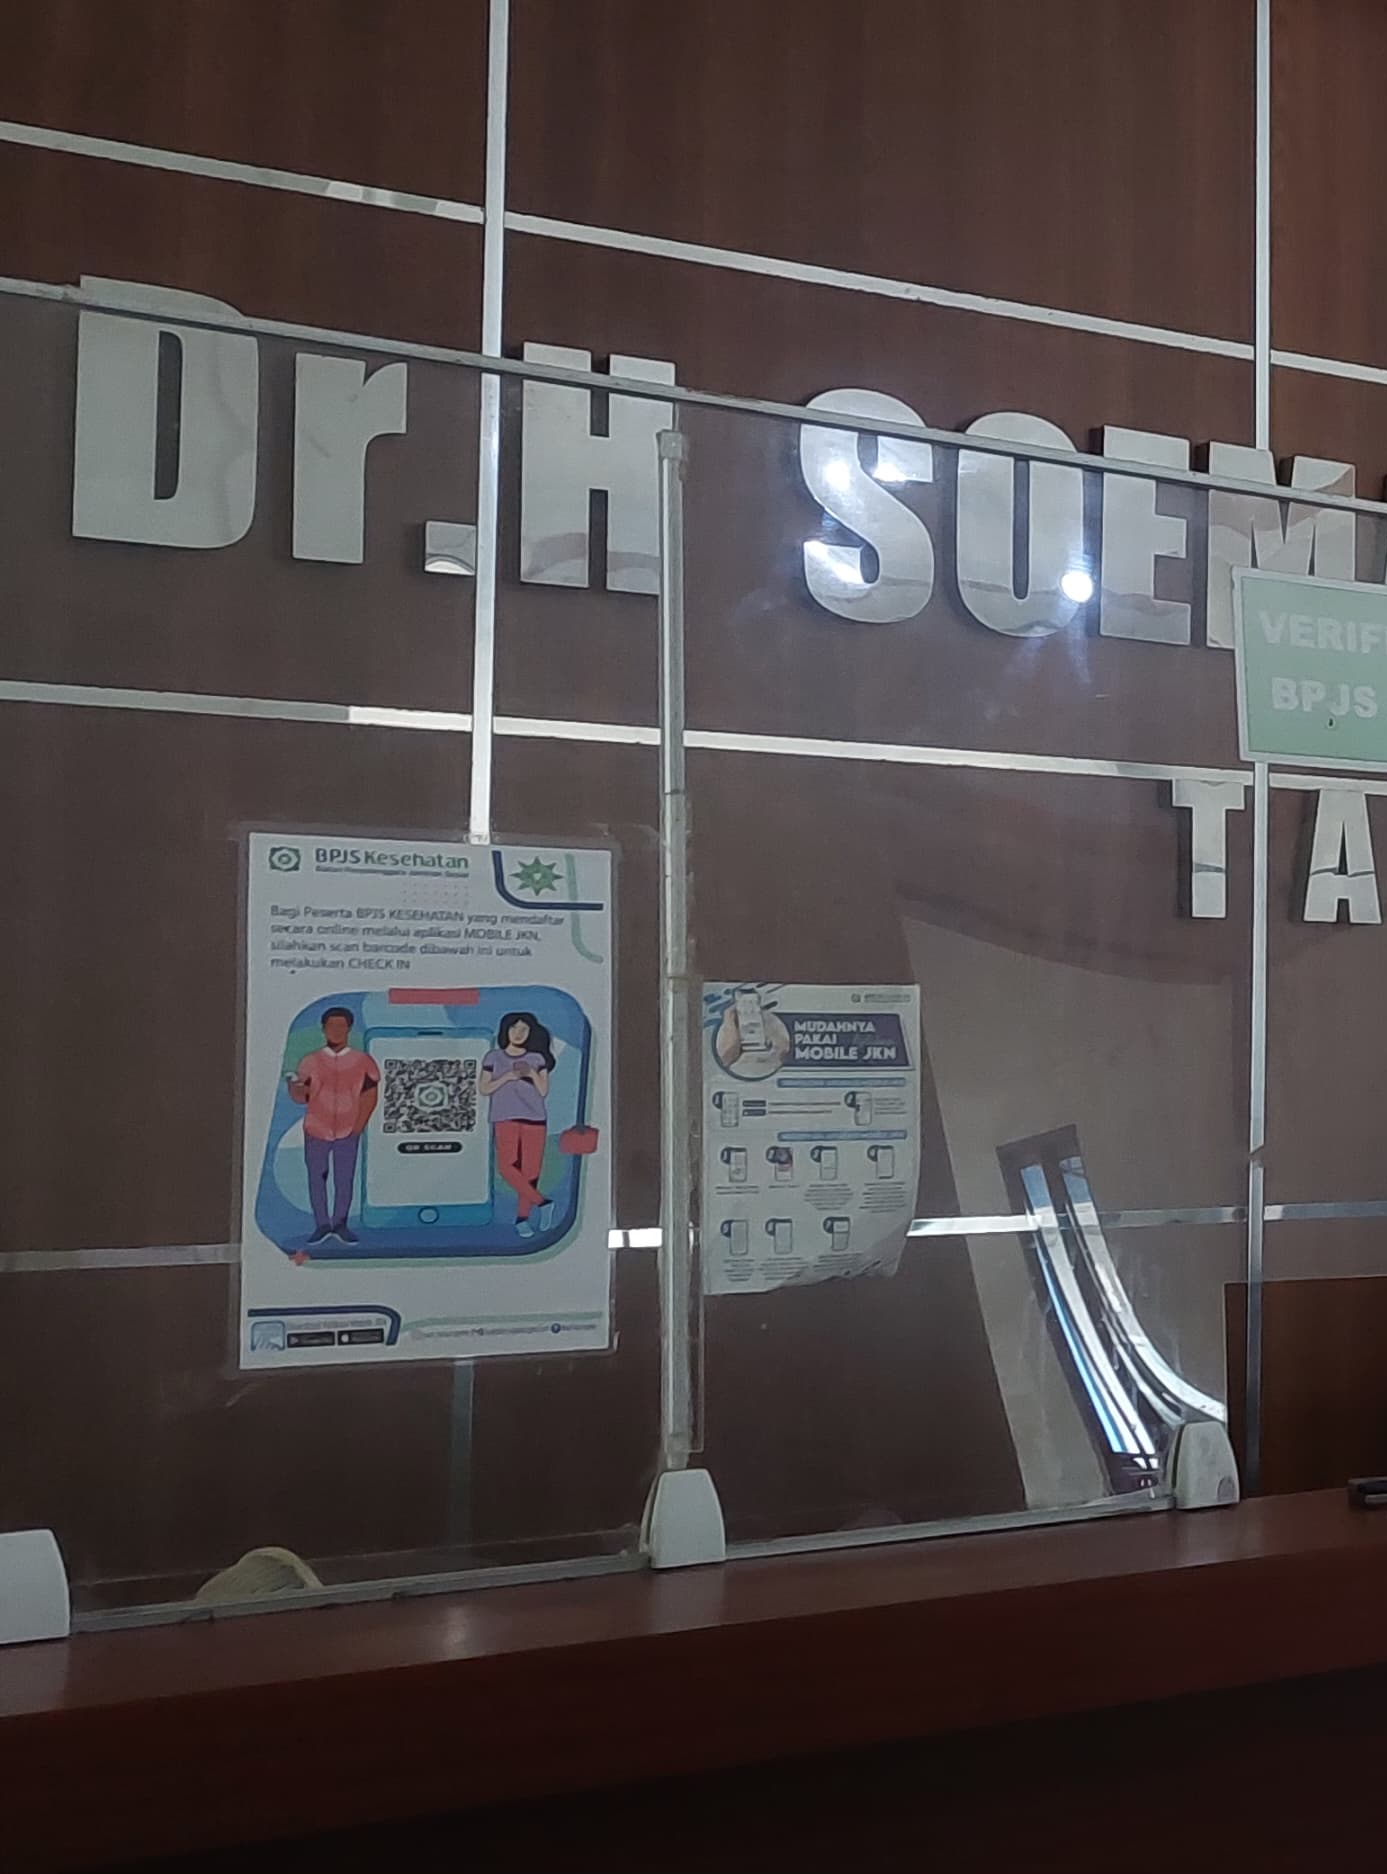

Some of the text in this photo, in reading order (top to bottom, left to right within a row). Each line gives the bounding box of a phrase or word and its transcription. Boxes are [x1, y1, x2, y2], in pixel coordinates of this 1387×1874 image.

[73, 275, 676, 595] Dr.H
[1271, 677, 1378, 718] BPJS
[315, 847, 469, 869] BPJS Kesehatan
[271, 905, 300, 920] Bagi
[304, 906, 353, 919] Peserta
[356, 907, 386, 920] BPJS
[388, 908, 464, 922] KESEHATAN
[466, 914, 498, 926] yang
[271, 925, 313, 935] secara
[317, 924, 359, 936] online
[464, 928, 512, 940] MOBILE
[330, 943, 360, 952] scan
[362, 941, 417, 954] barcode
[420, 943, 474, 955] dibawah
[270, 957, 410, 970] melakukan CHECK IN
[794, 1020, 876, 1034] MUDAHNYA
[794, 1033, 838, 1046] PAKAI
[794, 1046, 897, 1060] MOBILE JKN
